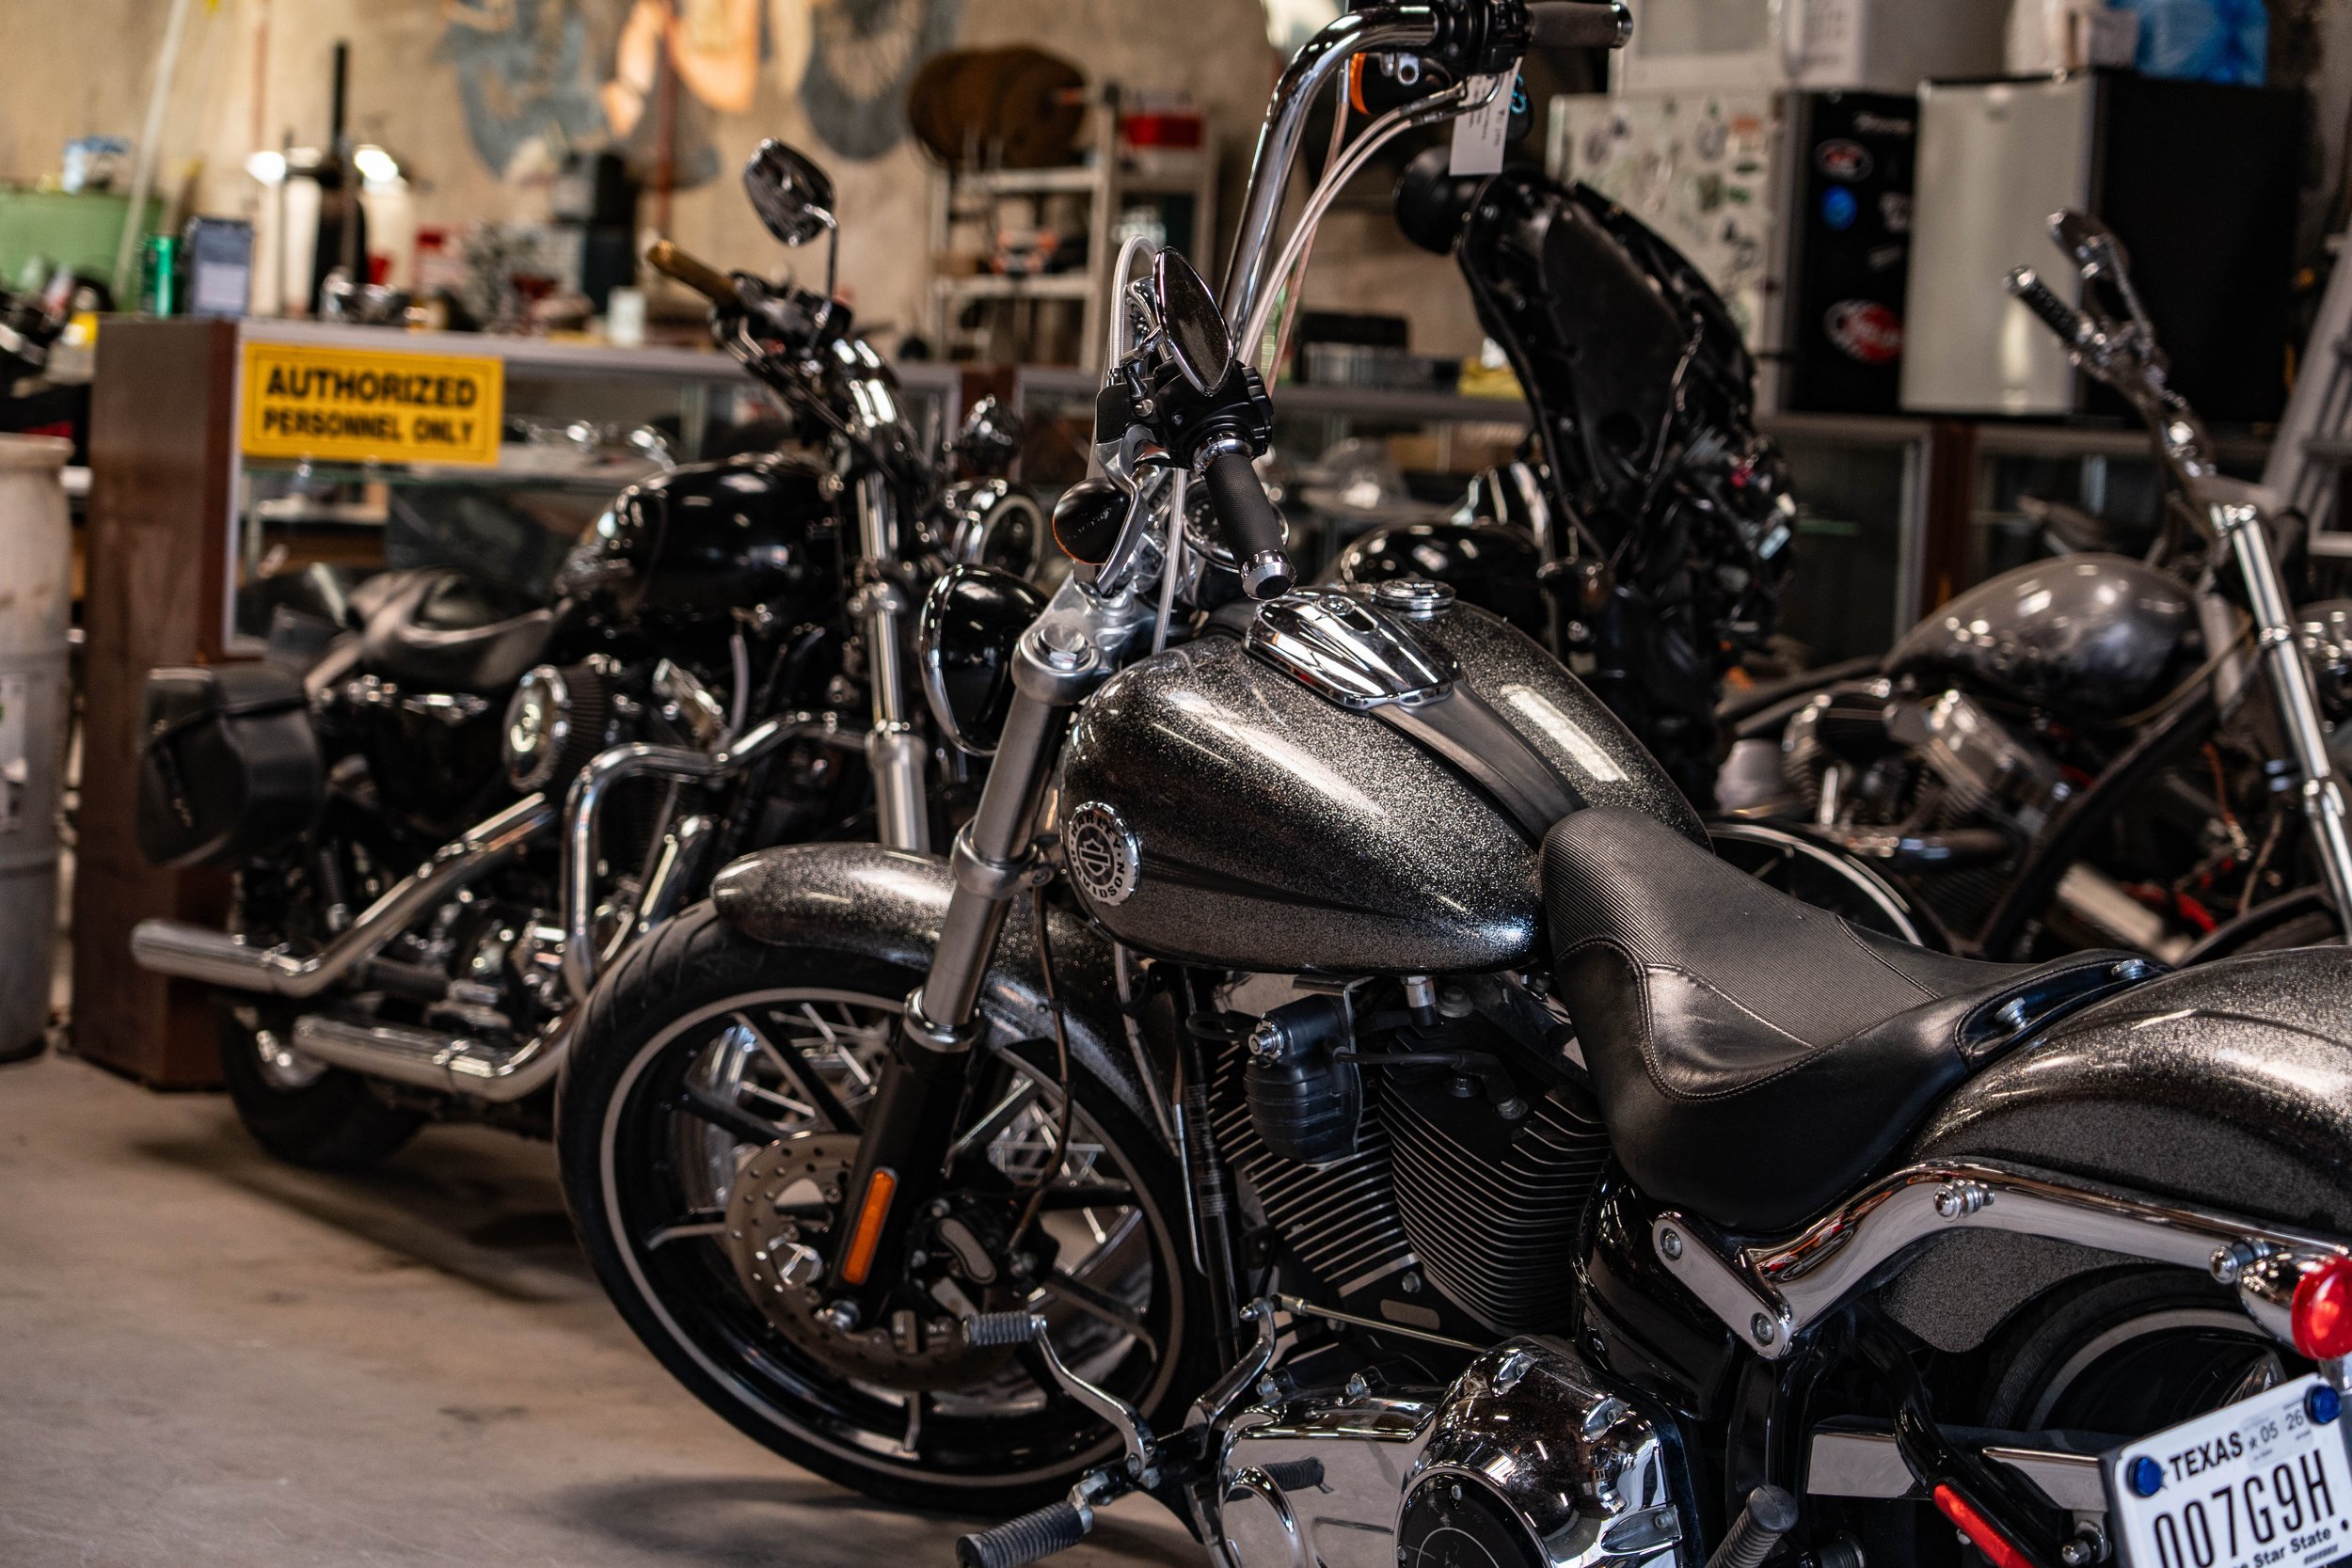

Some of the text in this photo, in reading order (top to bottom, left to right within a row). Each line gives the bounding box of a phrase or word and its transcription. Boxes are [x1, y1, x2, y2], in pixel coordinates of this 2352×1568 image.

[266, 364, 478, 408] AUTHORIZED
[262, 406, 474, 446] PERSONNEL ONLY
[1071, 812, 1122, 849] HARLEY
[1071, 849, 1125, 898] DAVIDSON
[2260, 1420, 2279, 1443] 05
[2285, 1409, 2304, 1431] 26
[2169, 1431, 2244, 1481] TEXAS
[2153, 1449, 2336, 1568] 007G9H
[2253, 1528, 2331, 1568] Star State
